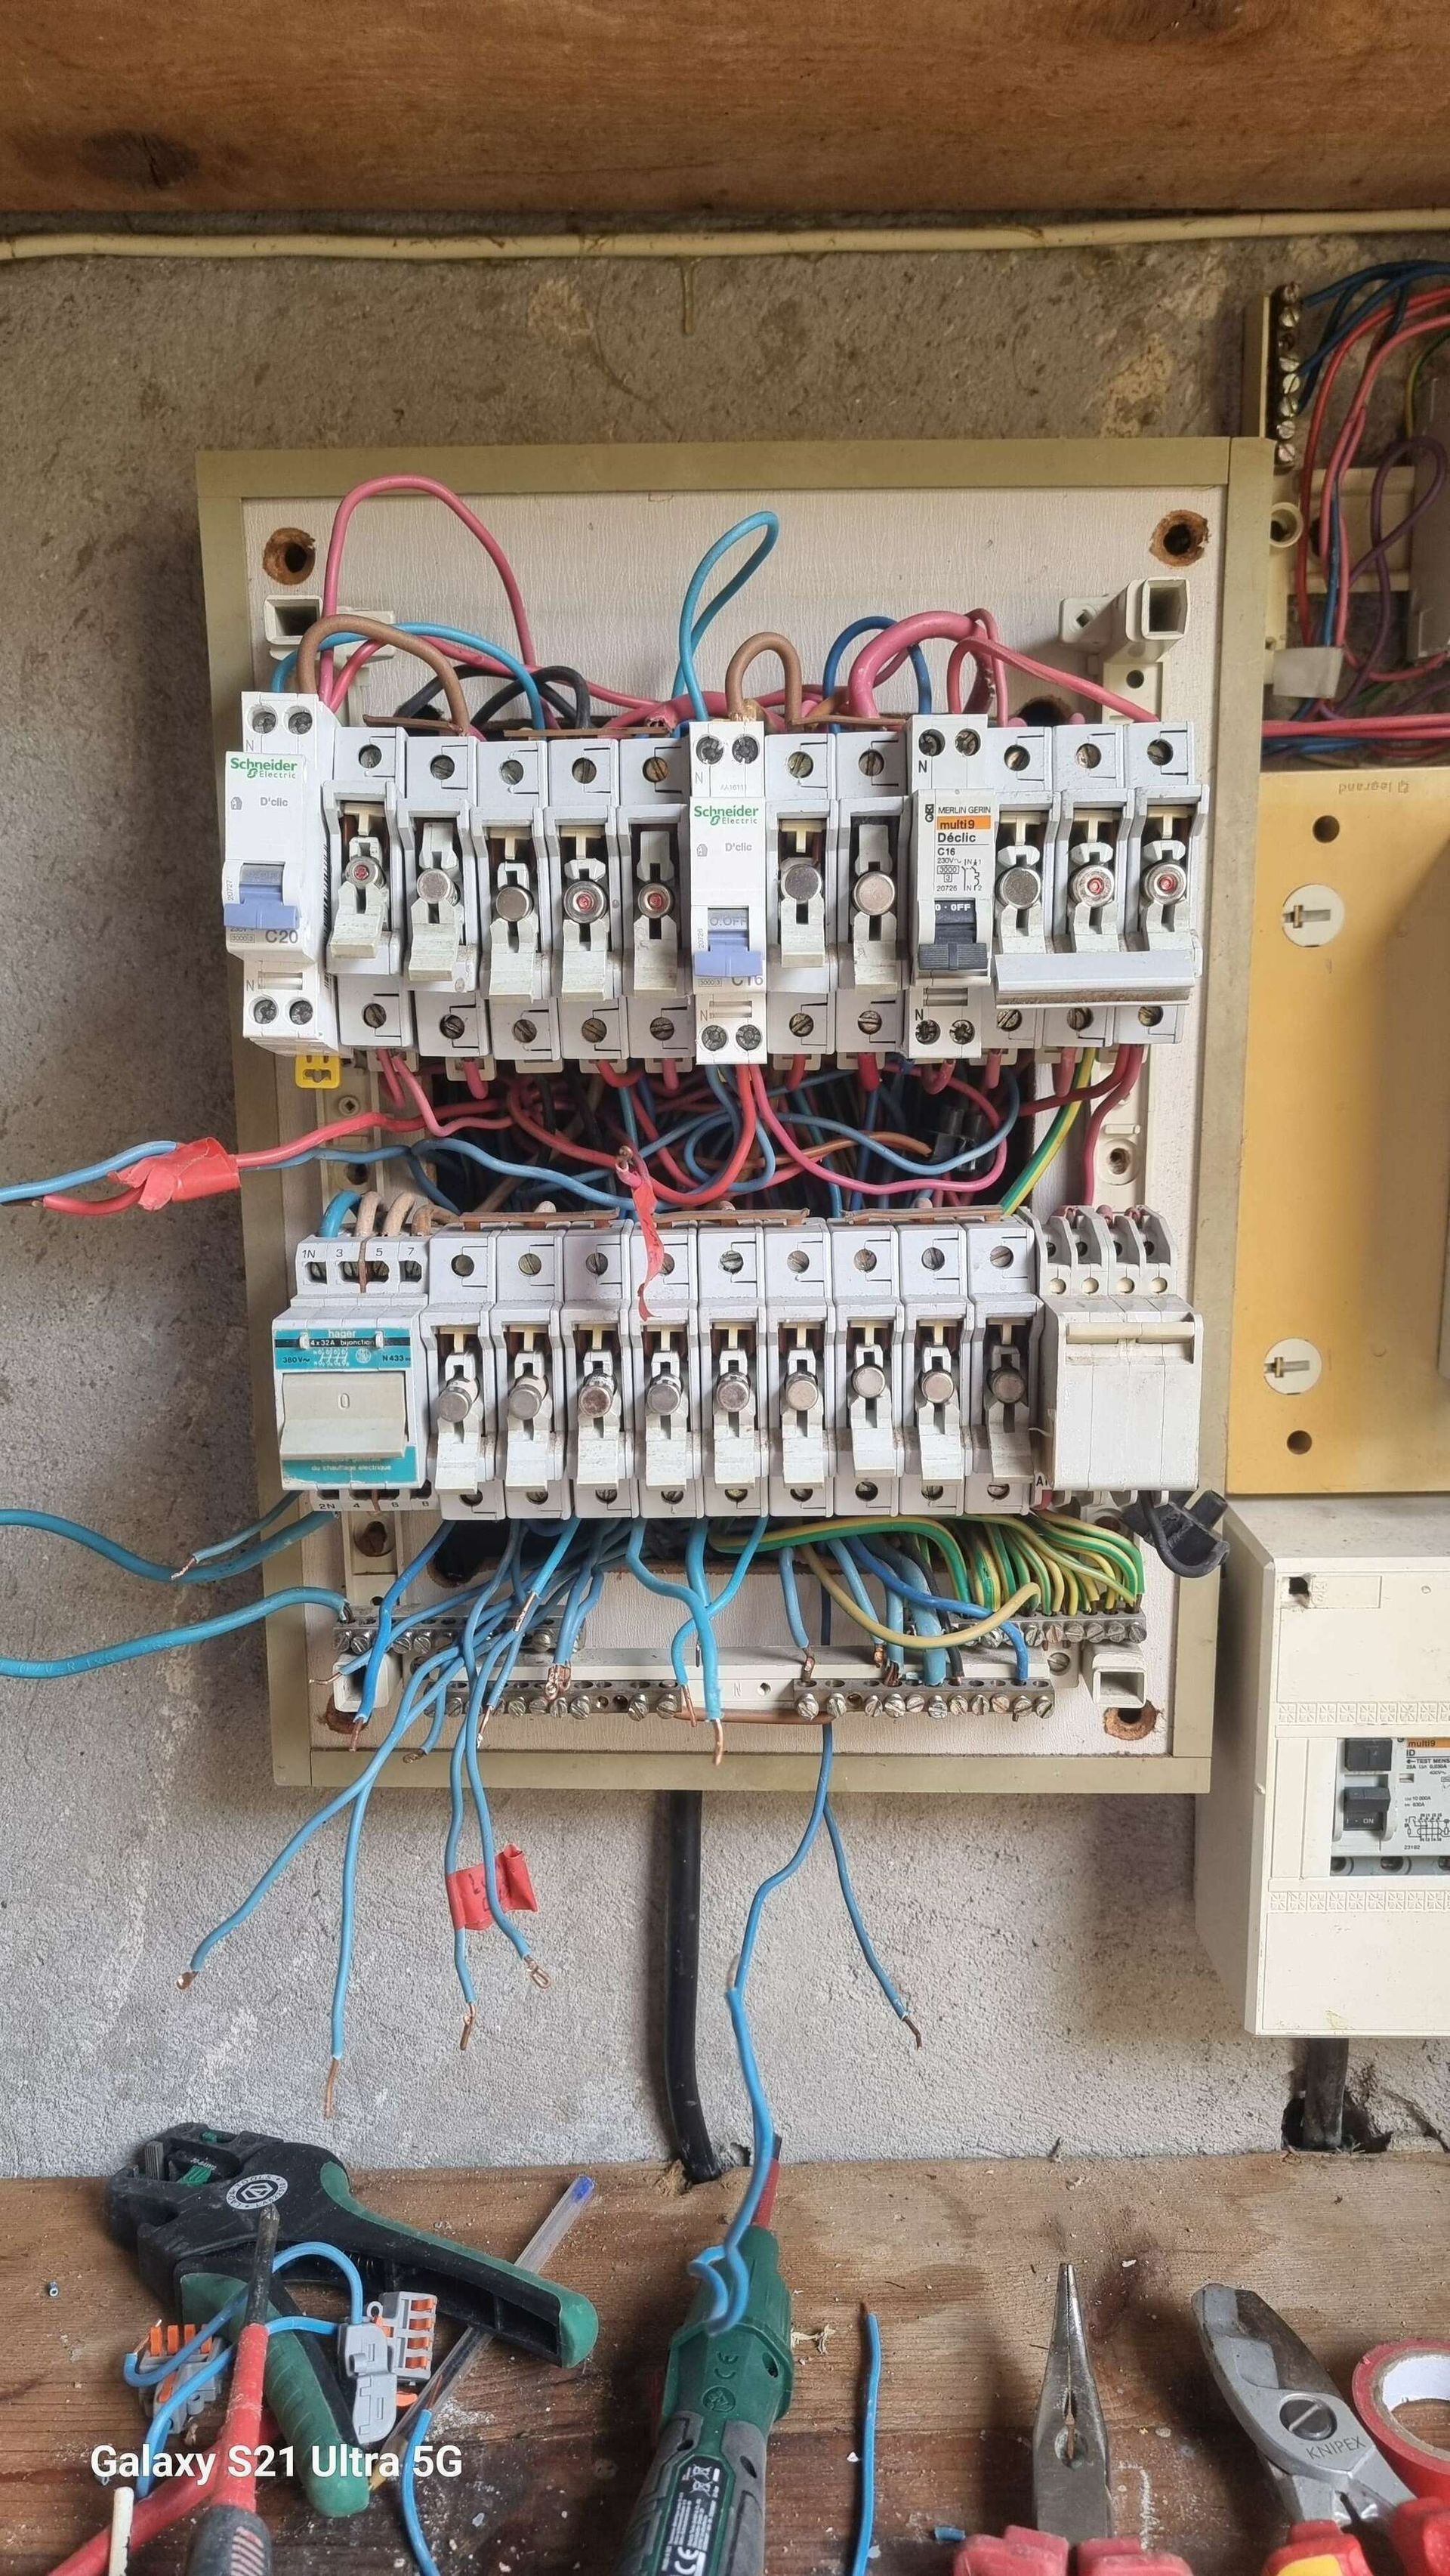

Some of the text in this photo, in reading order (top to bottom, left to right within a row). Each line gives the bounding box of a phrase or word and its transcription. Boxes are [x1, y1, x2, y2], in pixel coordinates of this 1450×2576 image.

[245, 739, 255, 752] N
[230, 757, 298, 771] Schneider
[918, 759, 927, 773] N
[258, 771, 296, 779] Electric
[695, 771, 703, 784] N
[693, 805, 760, 817] Schneider
[938, 806, 967, 814] MERLIN
[721, 817, 758, 825] Electric
[937, 832, 976, 843] Déclic
[724, 842, 753, 852] D'clic
[937, 848, 955, 856] C16
[265, 929, 299, 944] C20
[245, 979, 255, 992] N
[700, 1009, 708, 1021] N
[915, 1009, 924, 1021] N
[335, 1249, 344, 1258] 3
[375, 1247, 383, 1256] 5
[407, 1247, 415, 1256] 7
[1306, 2435, 1366, 2460] KNIPEX
